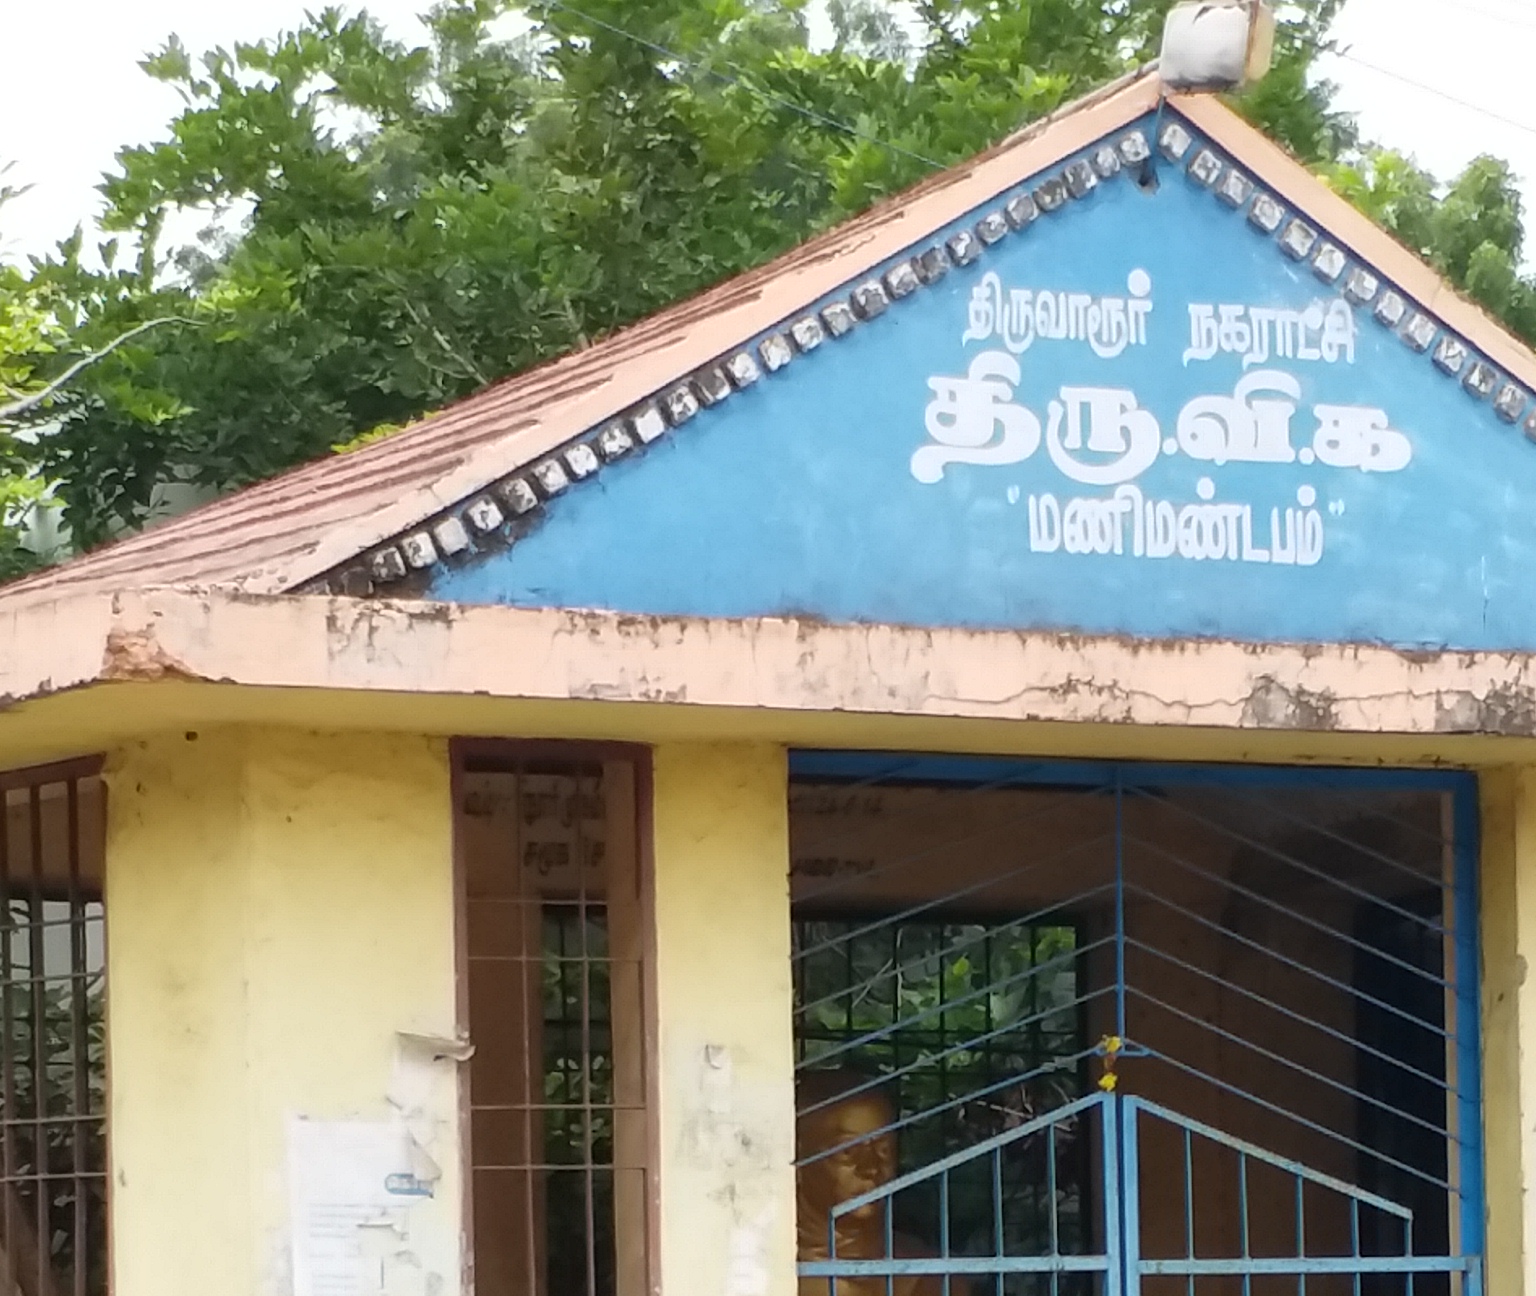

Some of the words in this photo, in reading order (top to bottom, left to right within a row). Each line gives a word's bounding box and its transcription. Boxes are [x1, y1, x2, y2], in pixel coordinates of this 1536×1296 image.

[963, 268, 1153, 358] திருவாரூர்
[1182, 300, 1358, 369] நகராட்சி
[910, 351, 1413, 485] திரு.வி.க
